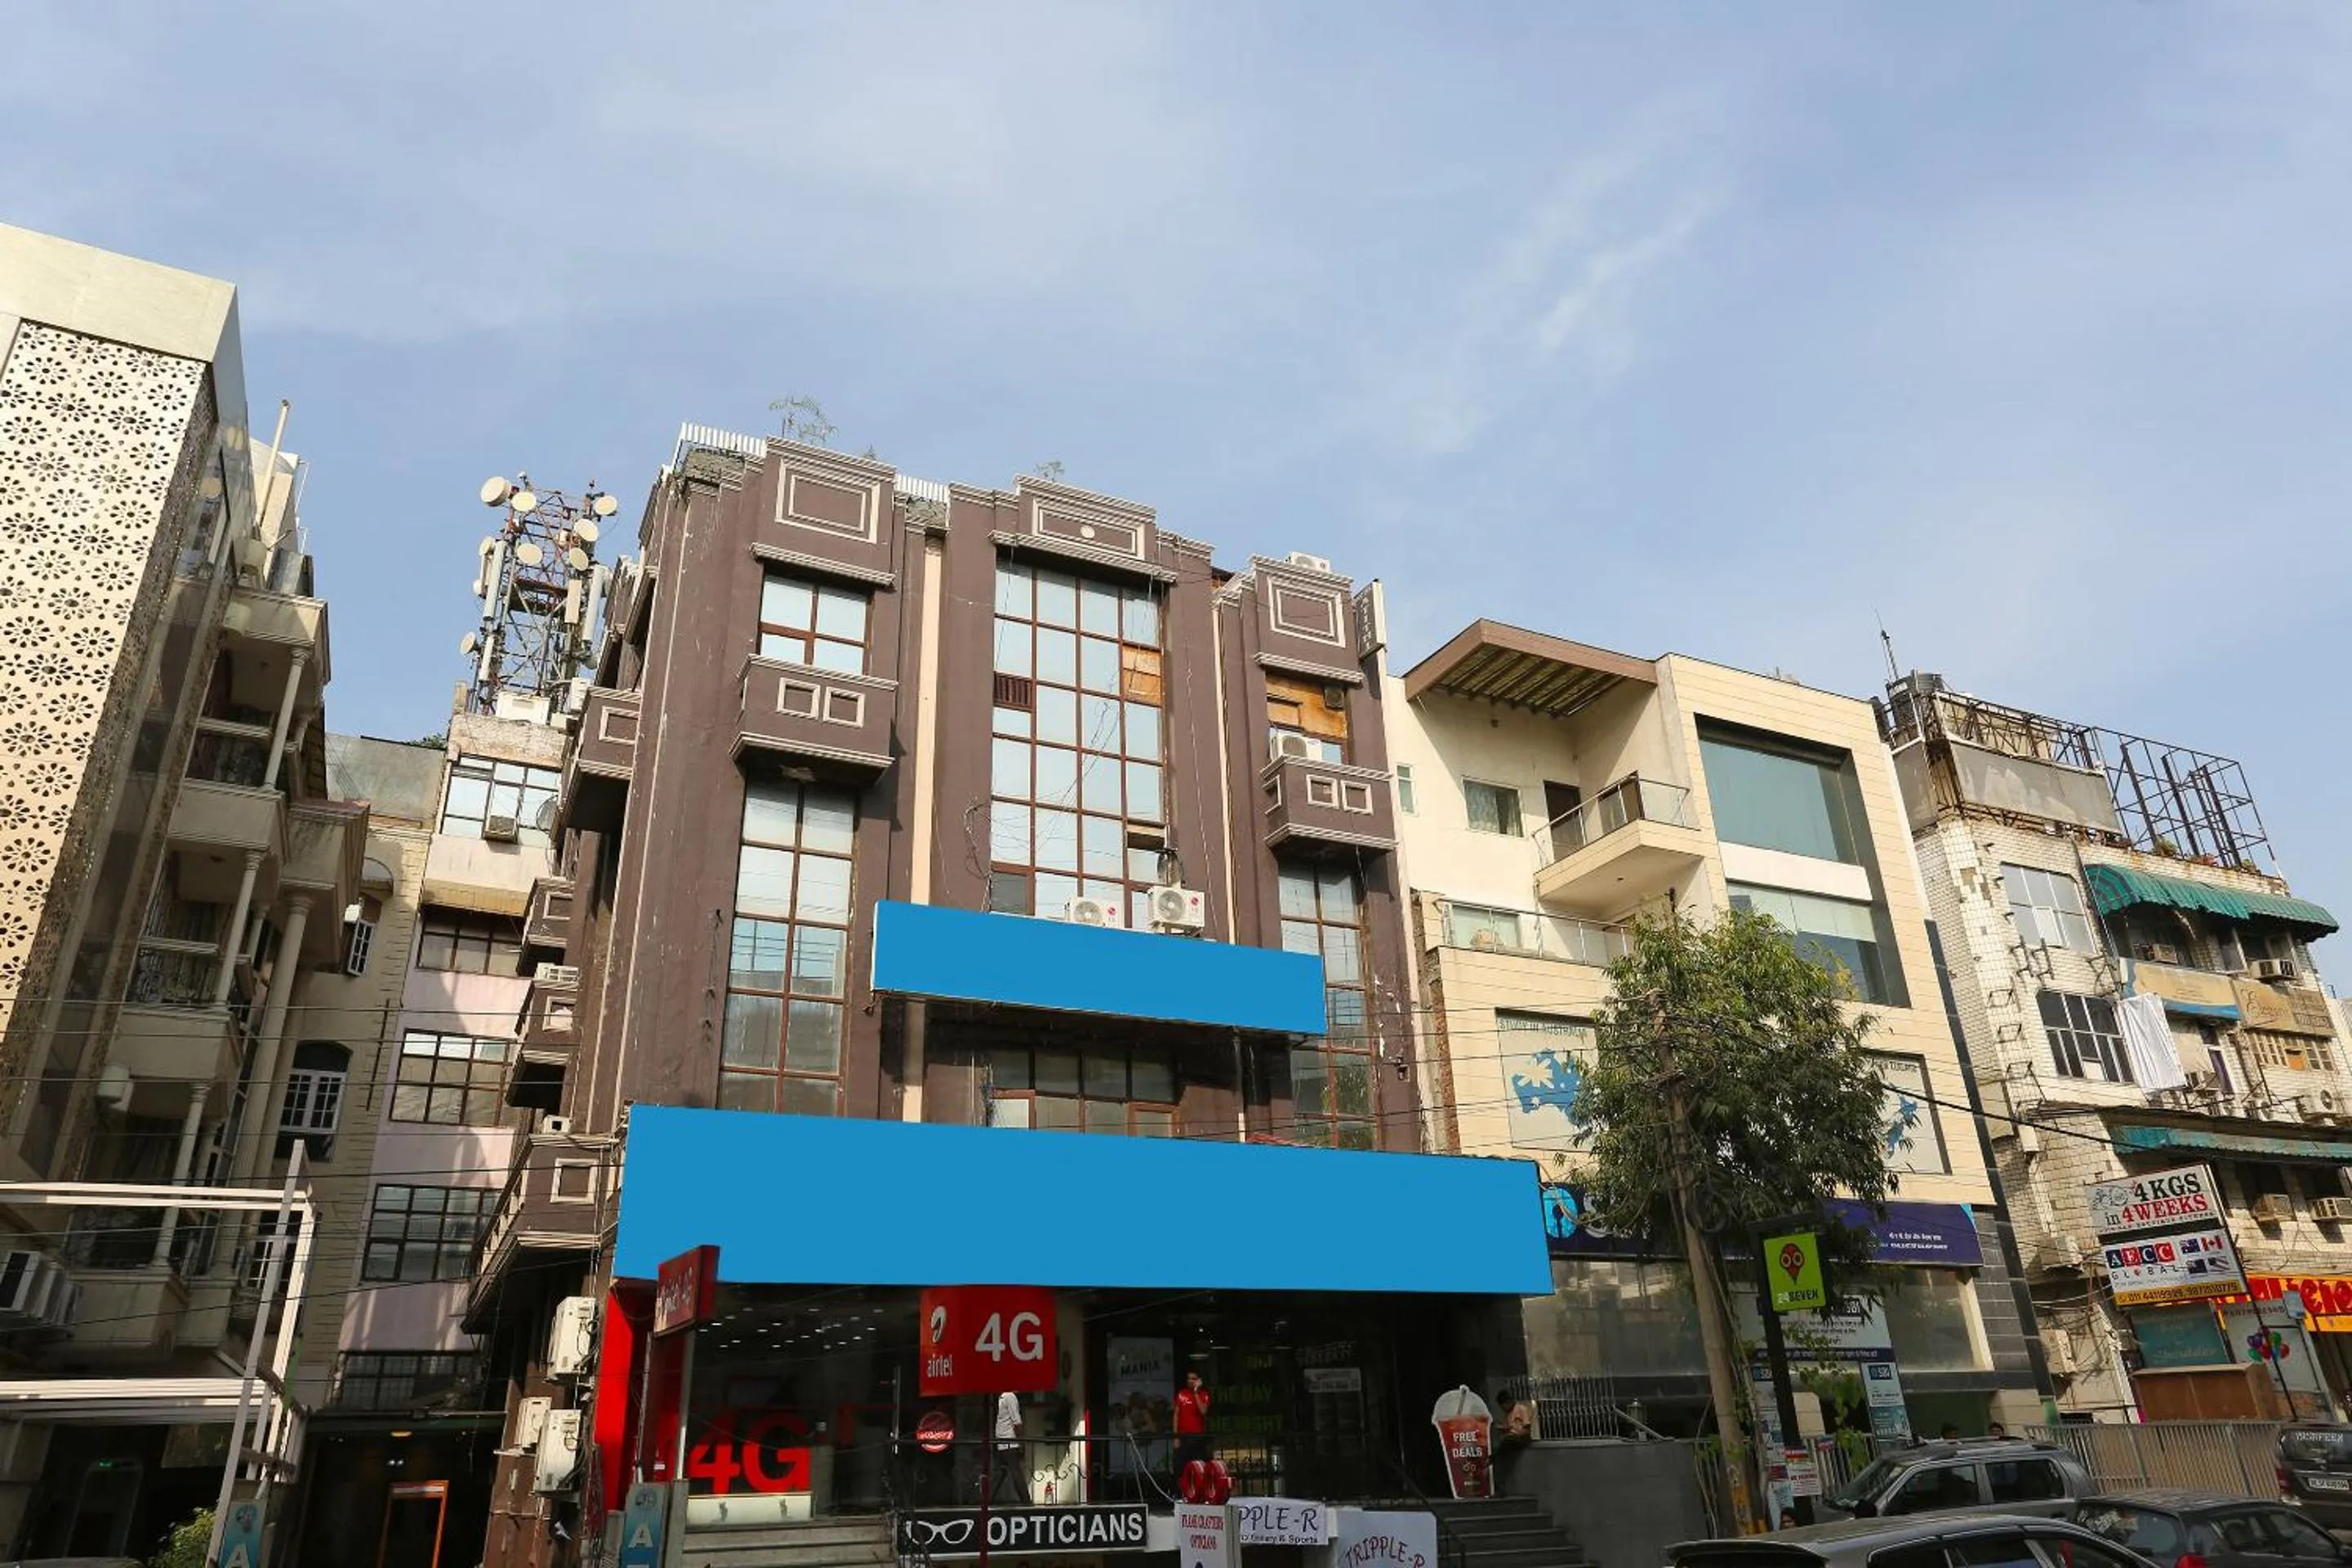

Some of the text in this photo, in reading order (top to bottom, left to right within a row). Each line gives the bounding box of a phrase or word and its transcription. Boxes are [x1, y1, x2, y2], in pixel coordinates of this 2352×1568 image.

[2105, 1211, 2120, 1225] in
[2108, 1244, 2173, 1268] AECC
[974, 1311, 1044, 1362] 4G
[926, 1353, 953, 1379] airtel
[1120, 1361, 1160, 1379] MANIA
[1452, 1430, 1480, 1443] FREE
[688, 1410, 812, 1494] 4G
[1451, 1446, 1482, 1459] DEALS
[987, 1511, 1143, 1546] OPTICIANS
[1238, 1504, 1319, 1533] PPLE-R
[1288, 1535, 1319, 1544] Sports
